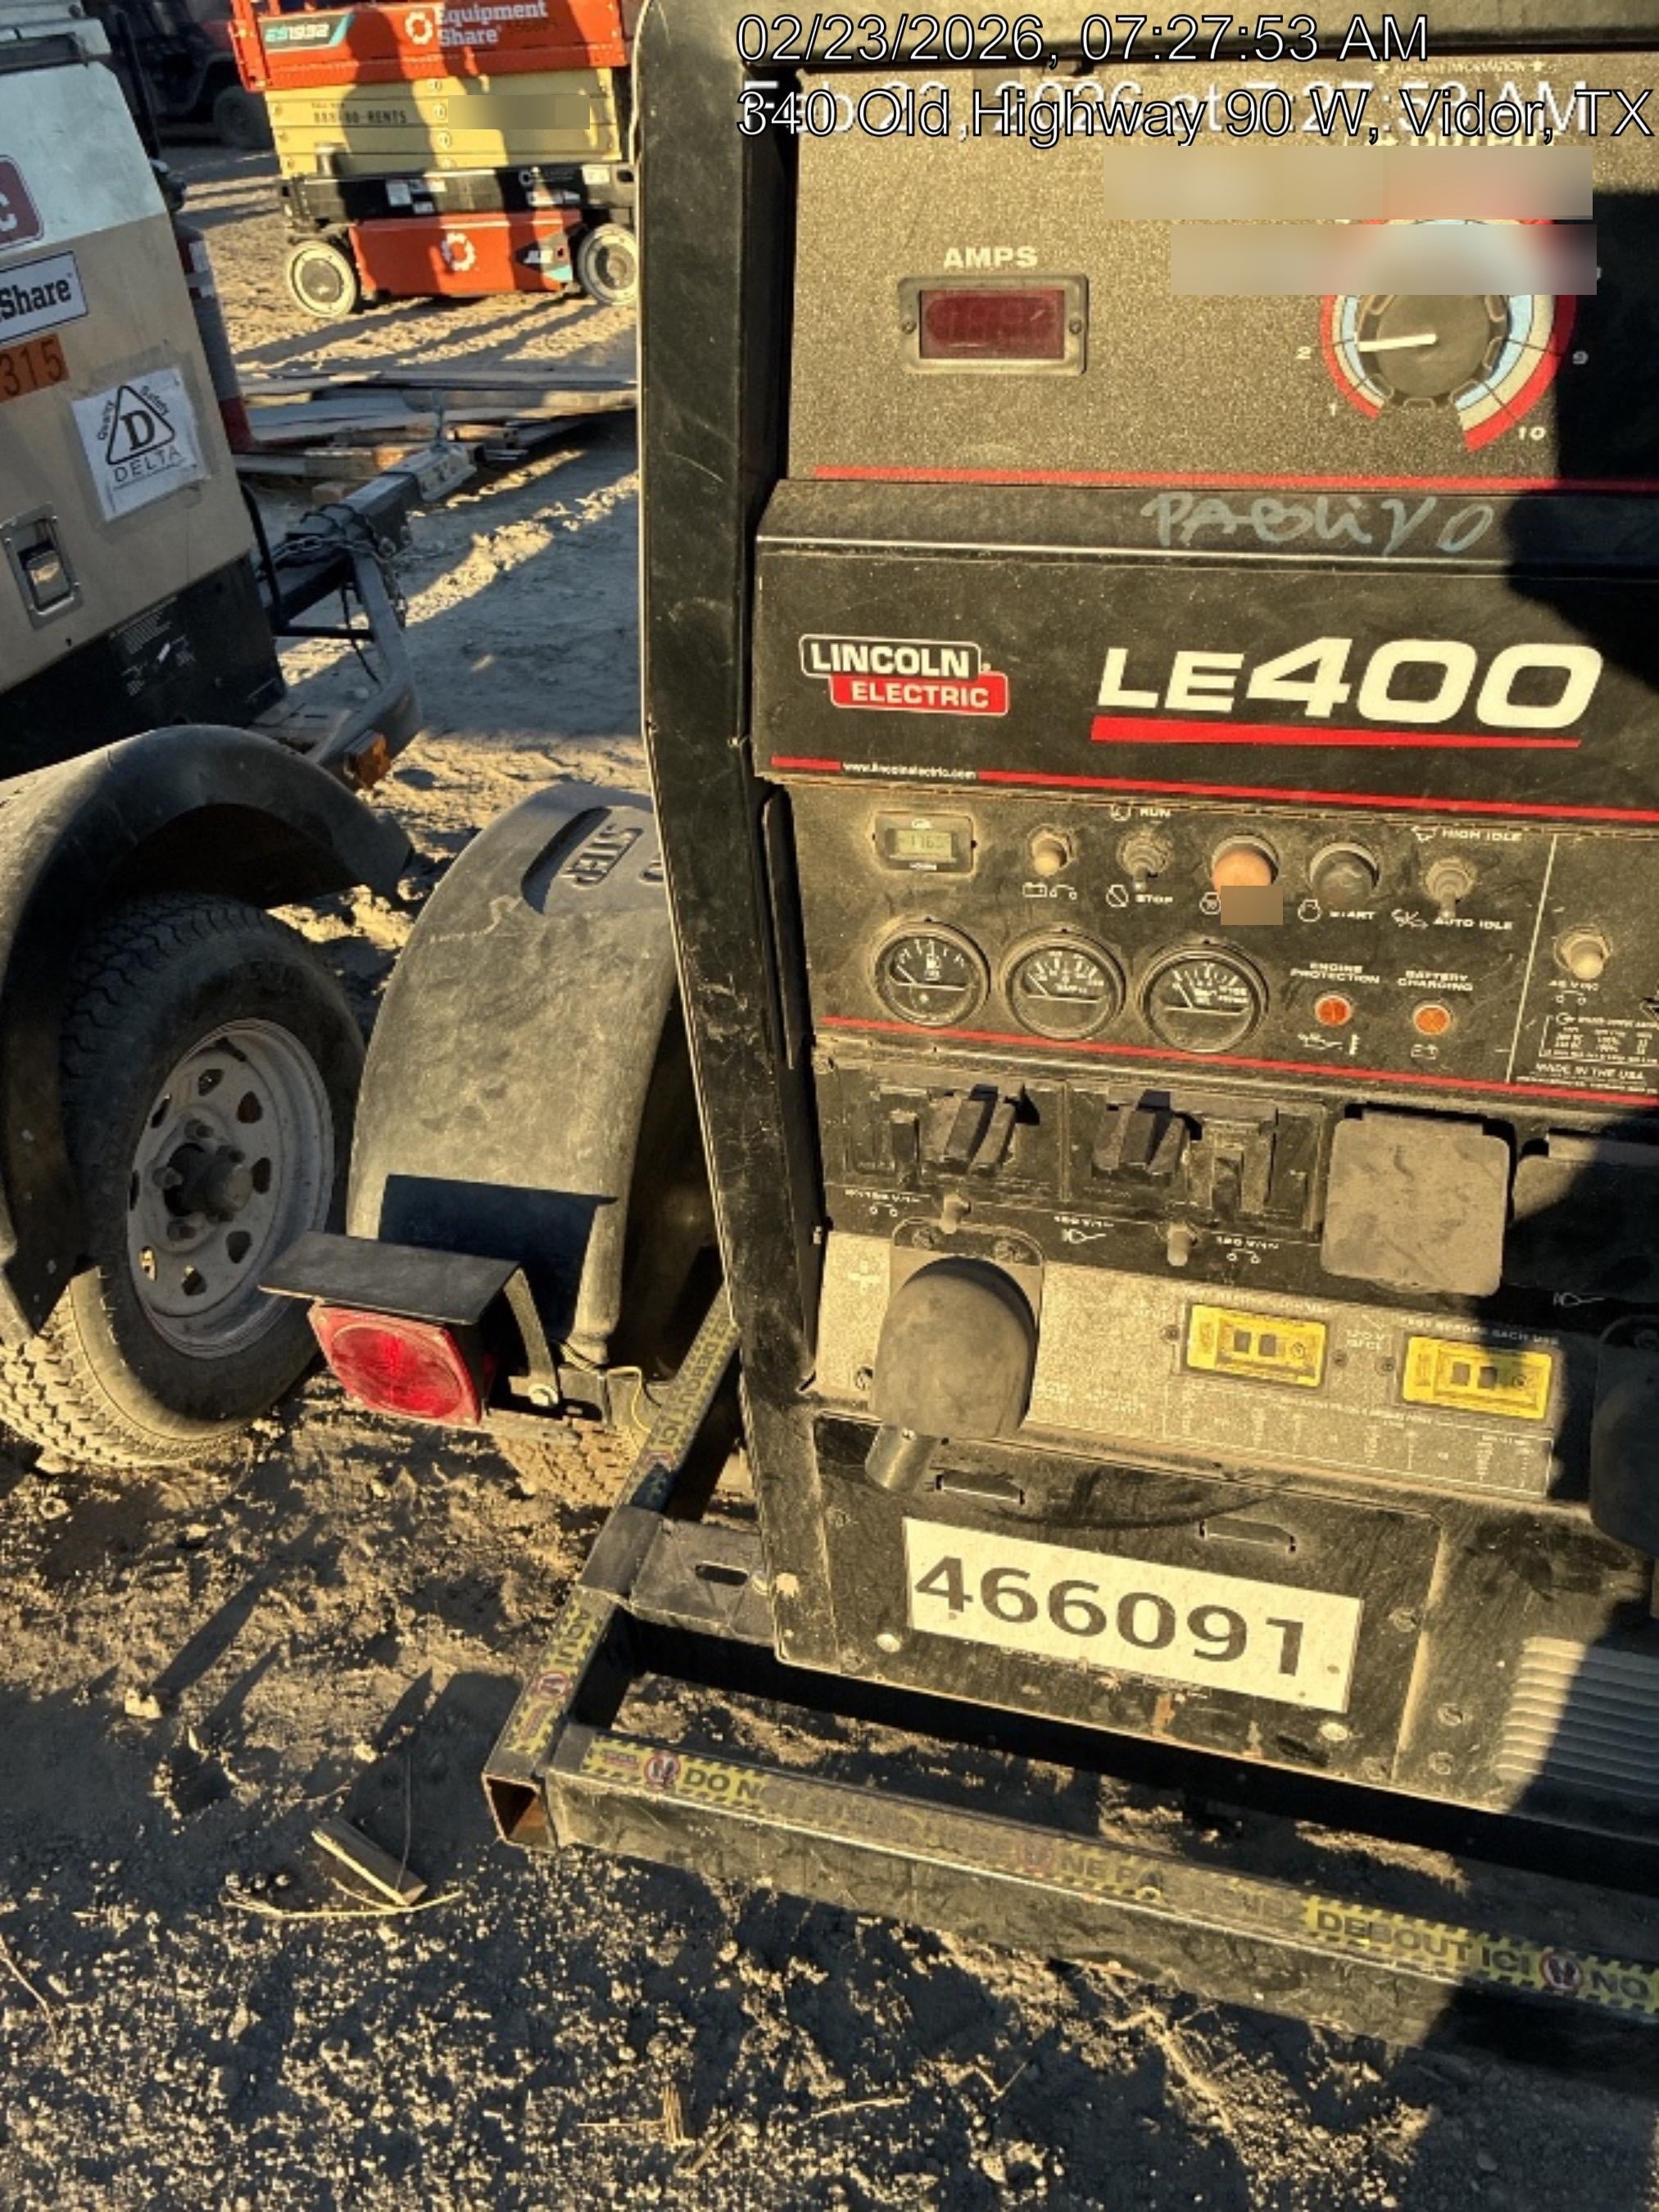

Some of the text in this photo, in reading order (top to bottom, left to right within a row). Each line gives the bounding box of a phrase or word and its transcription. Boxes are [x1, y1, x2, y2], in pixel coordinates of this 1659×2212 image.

[437, 2, 547, 25] Equipment
[437, 27, 500, 47] Share
[943, 247, 1038, 269] AMPS
[0, 278, 72, 320] Share
[1296, 347, 1311, 360] 2
[1327, 402, 1338, 417] 1
[119, 409, 155, 451] D
[1517, 425, 1547, 440] 10
[114, 443, 182, 483] DELTA
[810, 642, 970, 678] LINCOLN
[1096, 636, 1604, 728] LE400
[851, 680, 990, 709] ELECTRIC
[1140, 808, 1171, 818] RUN
[1442, 829, 1522, 842] HIGH IDLE
[1135, 893, 1174, 904] STOP
[1330, 910, 1376, 921] START
[1433, 917, 1514, 931] AUTO IDLE
[1290, 968, 1380, 984] PROTECTION
[1397, 977, 1473, 992] CHARGING
[915, 1556, 1304, 1677] 466091
[682, 1768, 731, 1793] DO
[1067, 1856, 1103, 1879] NE
[1317, 1910, 1471, 1960] DEBOUT
[1481, 1947, 1531, 1976] ICI
[1591, 1969, 1650, 1999] NO
